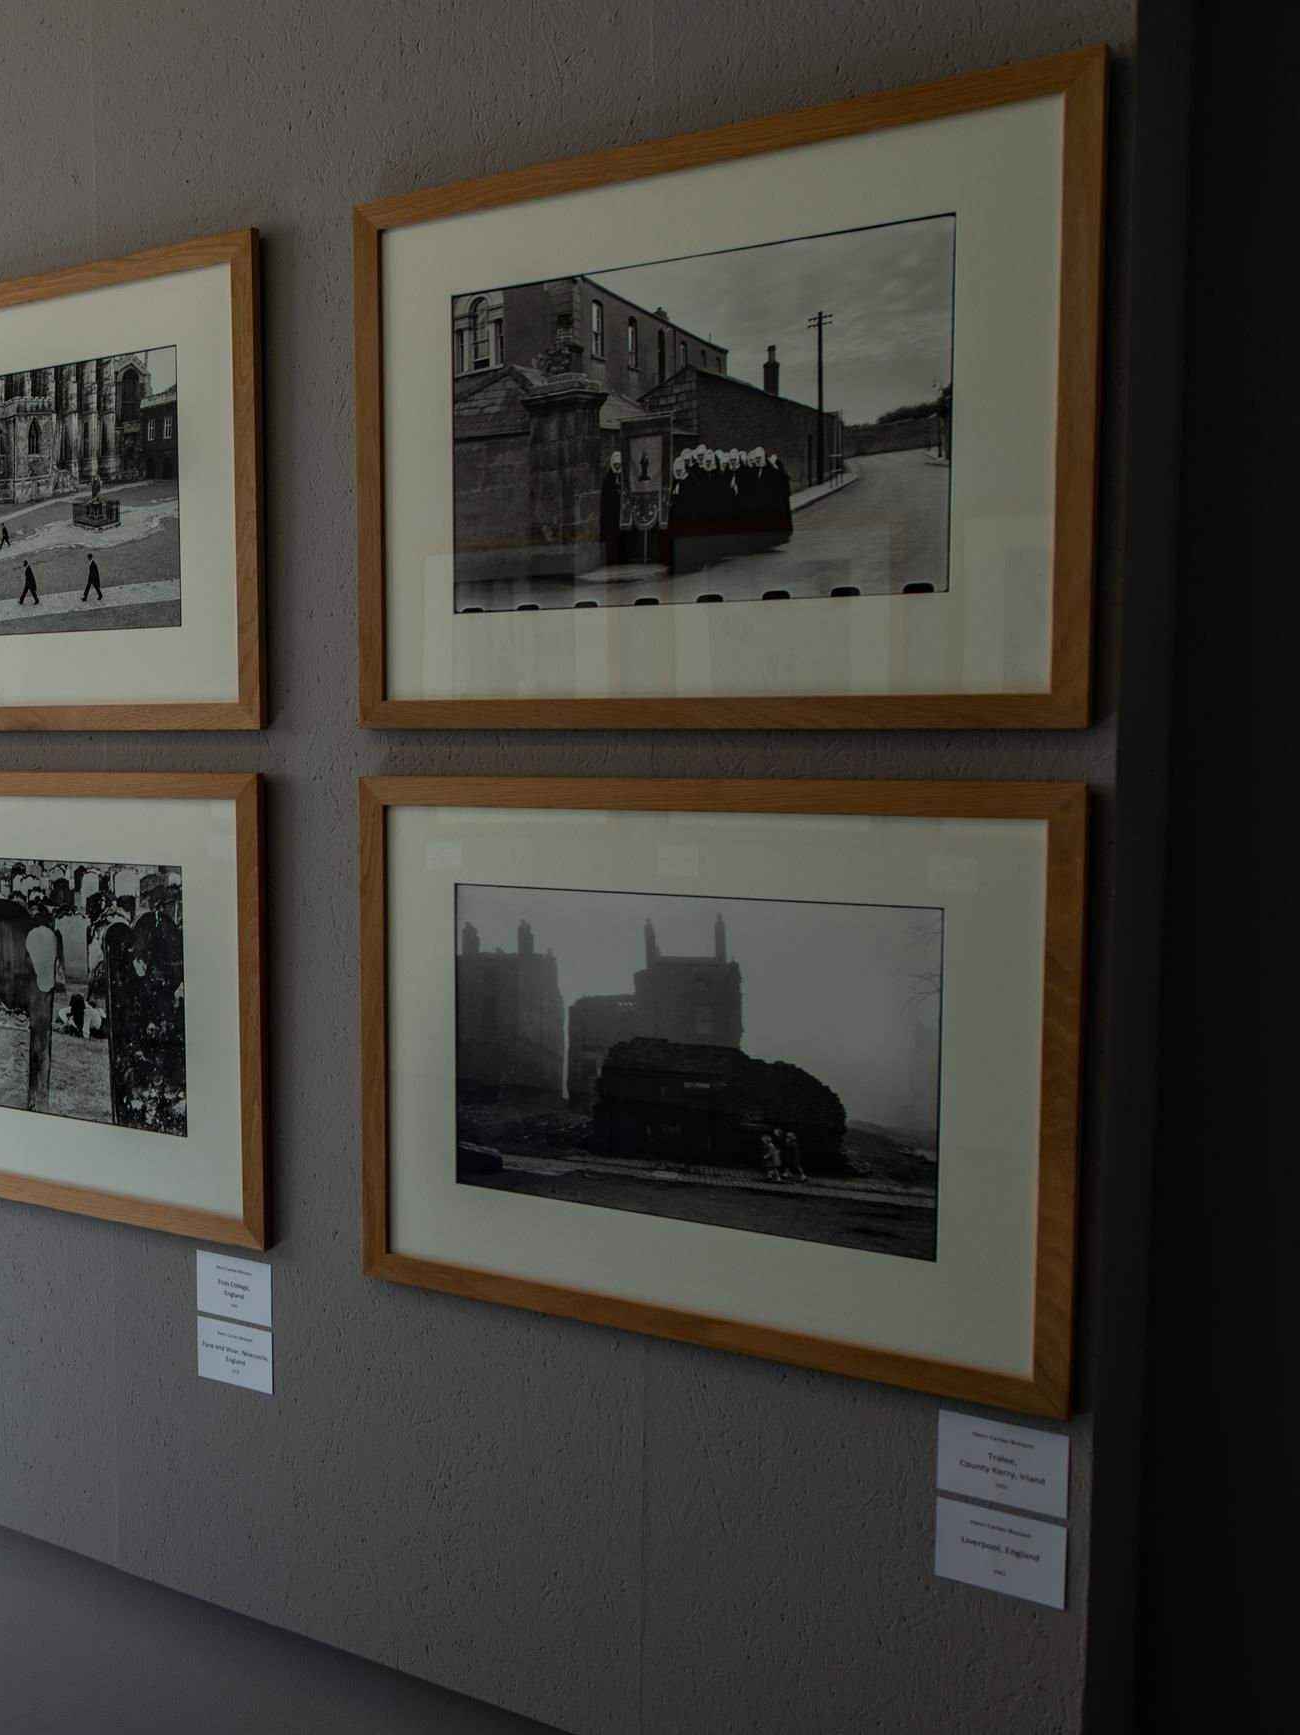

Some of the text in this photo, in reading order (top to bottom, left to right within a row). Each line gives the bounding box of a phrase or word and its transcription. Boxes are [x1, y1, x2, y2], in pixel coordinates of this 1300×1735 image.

[224, 1289, 245, 1300] England
[215, 1344, 225, 1352] and
[225, 1355, 246, 1366] England
[988, 1452, 1017, 1467] Tralee,
[959, 1459, 990, 1474] County
[992, 1467, 1018, 1480] Kerry,
[1020, 1472, 1046, 1486] Irland
[961, 1536, 1040, 1562] Liverpool, England
